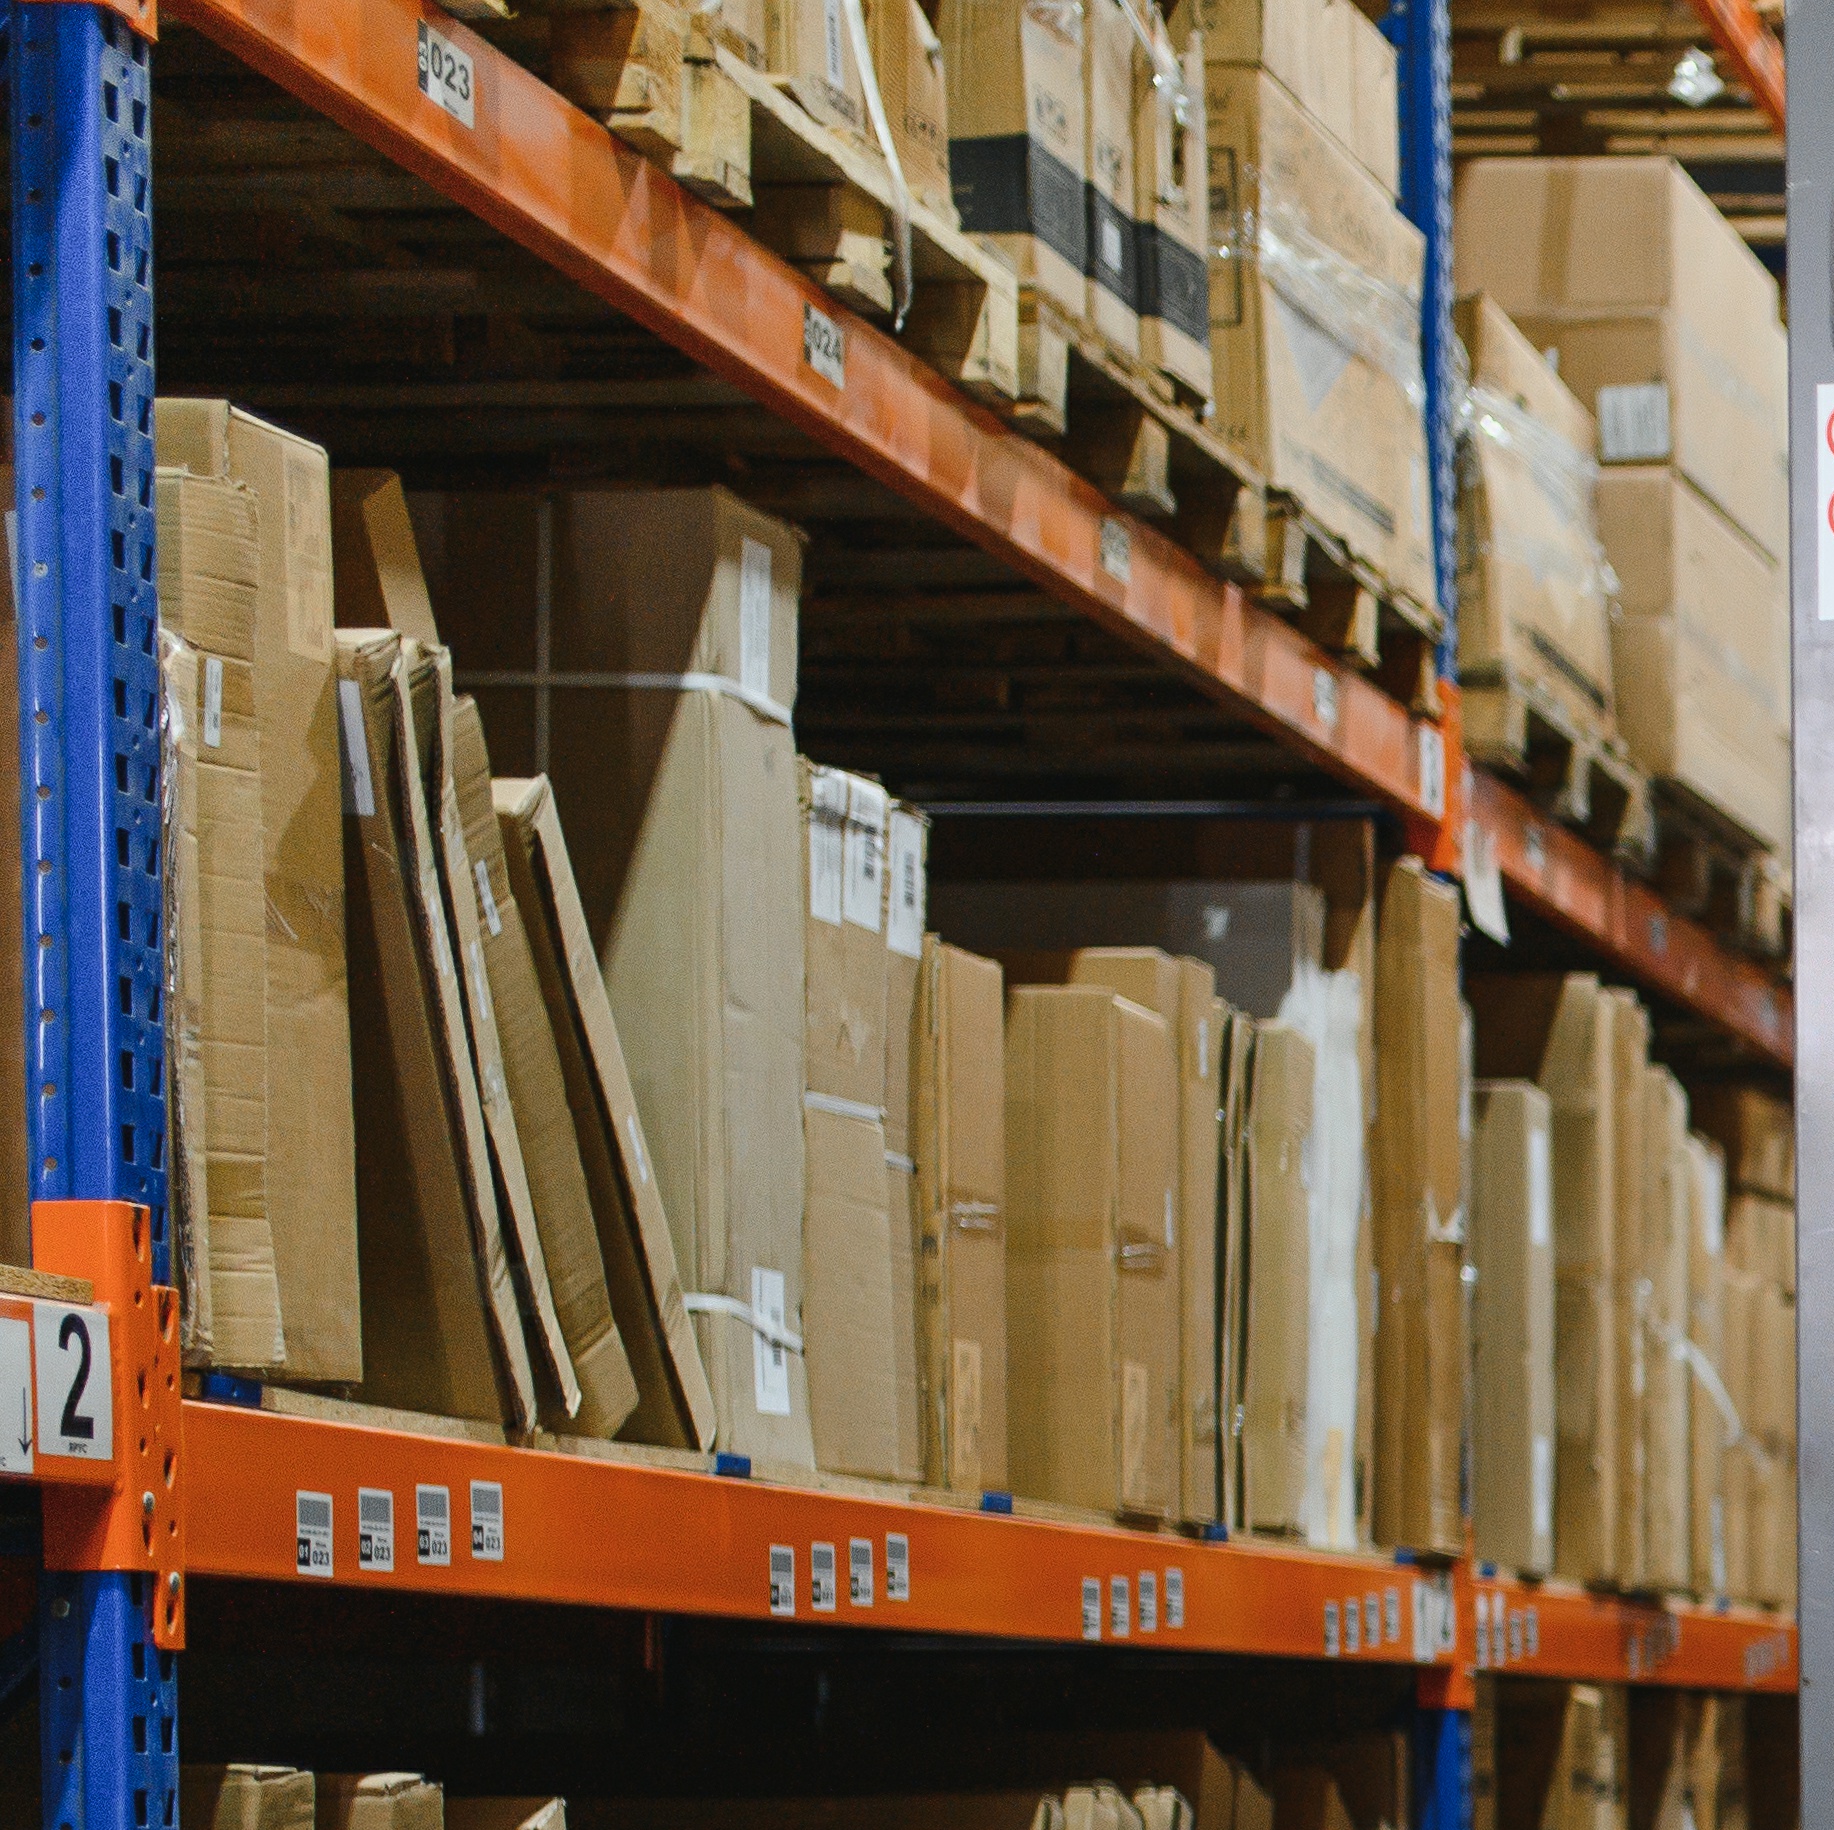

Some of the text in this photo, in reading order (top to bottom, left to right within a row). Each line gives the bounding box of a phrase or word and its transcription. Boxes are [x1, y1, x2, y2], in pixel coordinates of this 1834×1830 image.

[430, 41, 470, 101] 023
[58, 1312, 94, 1439] 2
[373, 1545, 390, 1561] 023
[431, 1540, 447, 1555] 023
[312, 1550, 330, 1566] 023
